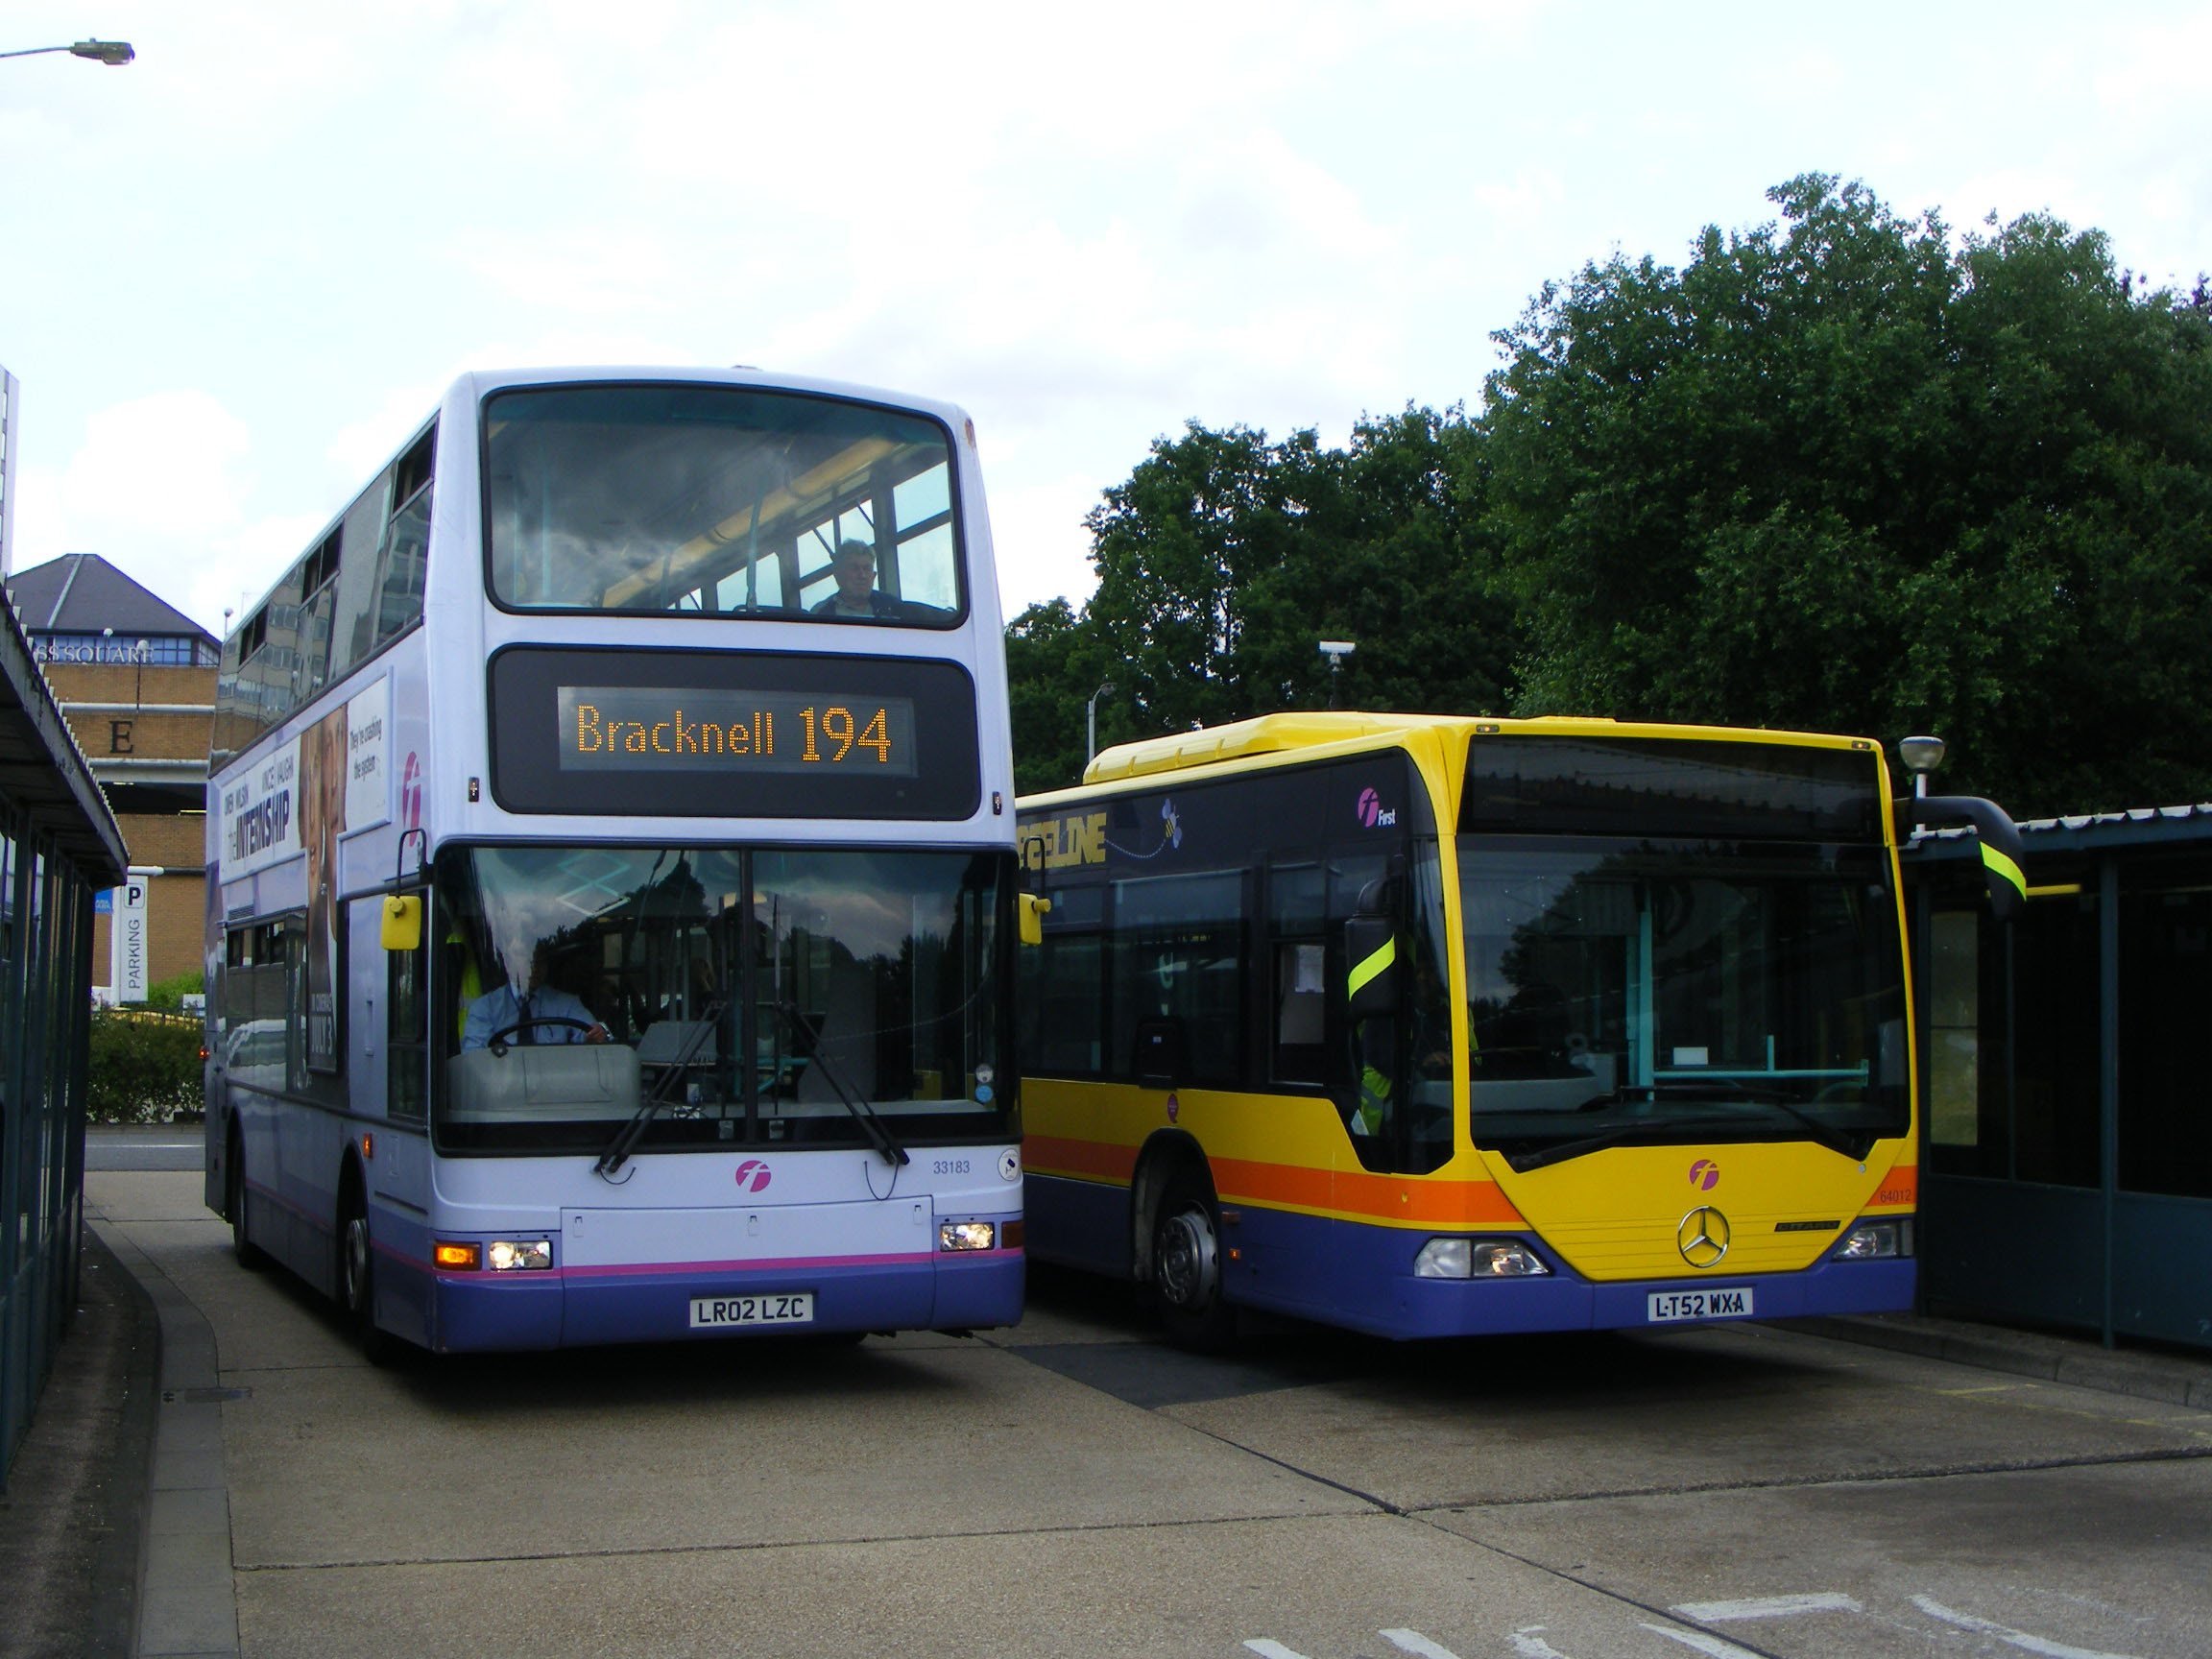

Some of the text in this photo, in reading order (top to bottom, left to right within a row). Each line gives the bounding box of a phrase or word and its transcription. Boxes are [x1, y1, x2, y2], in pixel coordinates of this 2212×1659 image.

[108, 720, 133, 754] E
[578, 704, 892, 763] Bracknell 194
[236, 788, 290, 861] INTERNSHIP
[1378, 808, 1396, 827] First
[128, 887, 141, 906] P
[128, 919, 141, 990] PARKING
[933, 1160, 971, 1174] 33183
[1880, 1190, 1911, 1203] 64012
[698, 1297, 805, 1323] LR02 LZC
[1656, 1292, 1744, 1317] LT52 WXA
